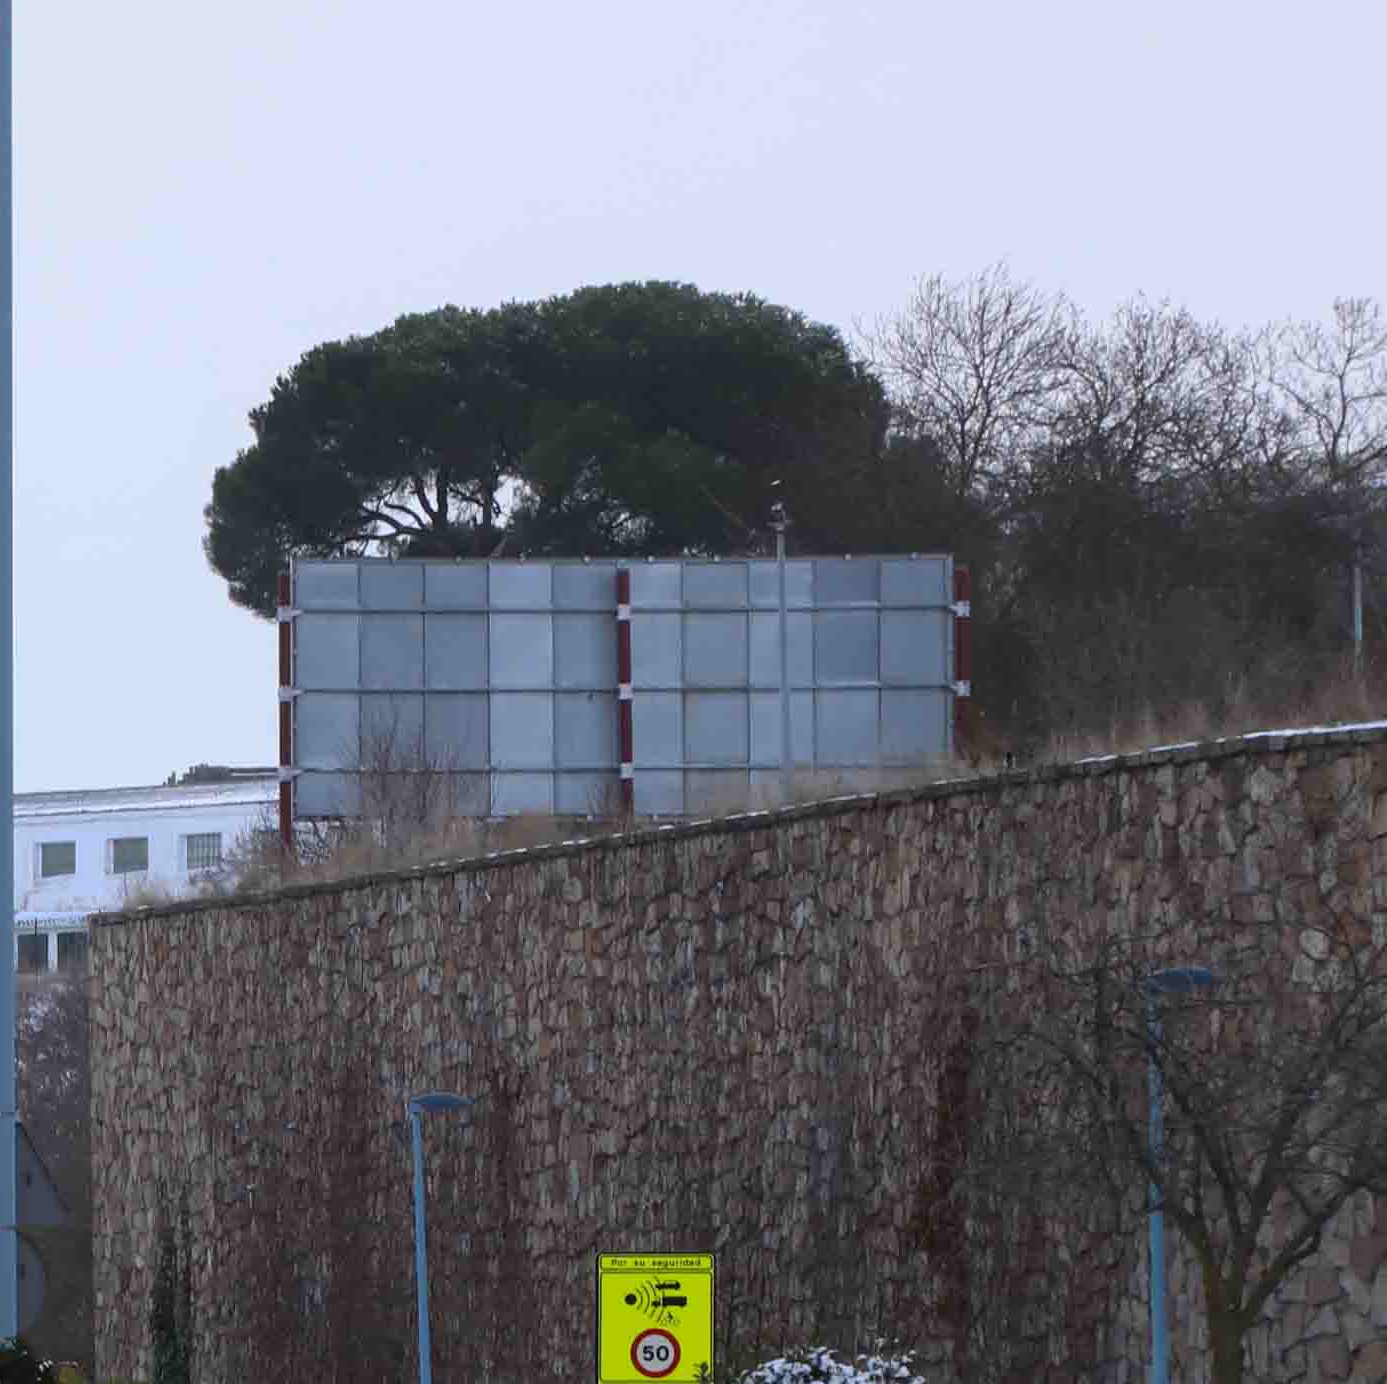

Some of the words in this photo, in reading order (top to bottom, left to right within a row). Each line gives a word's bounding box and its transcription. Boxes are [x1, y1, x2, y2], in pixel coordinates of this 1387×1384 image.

[611, 1258, 627, 1267] Por
[652, 1258, 702, 1269] seguridad
[642, 1345, 670, 1362] 50
